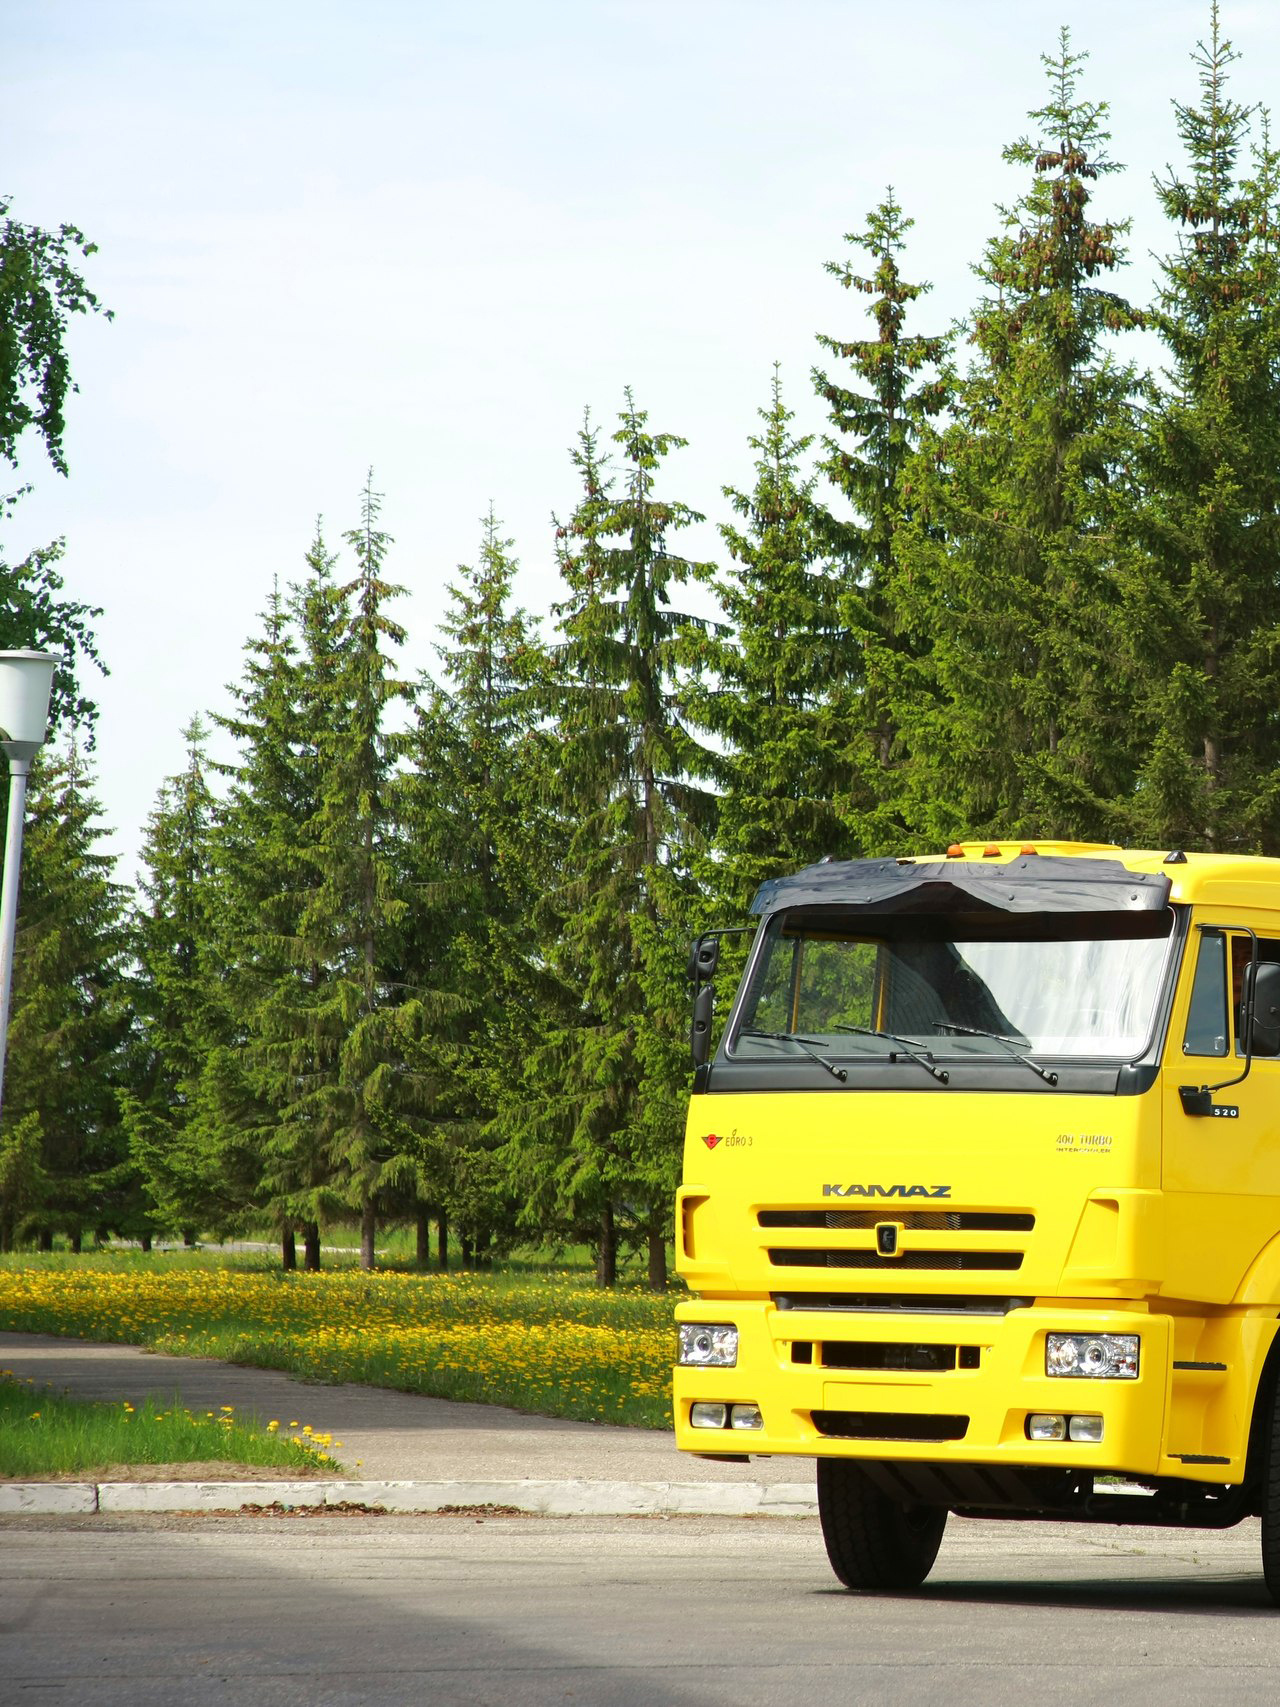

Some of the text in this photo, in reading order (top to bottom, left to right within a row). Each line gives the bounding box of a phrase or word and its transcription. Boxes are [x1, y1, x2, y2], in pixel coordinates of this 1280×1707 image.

[1214, 1108, 1237, 1117] 520
[725, 1136, 753, 1147] EURO 3
[1056, 1134, 1113, 1146] 400 TURBO
[822, 1184, 952, 1198] KAMAZ
